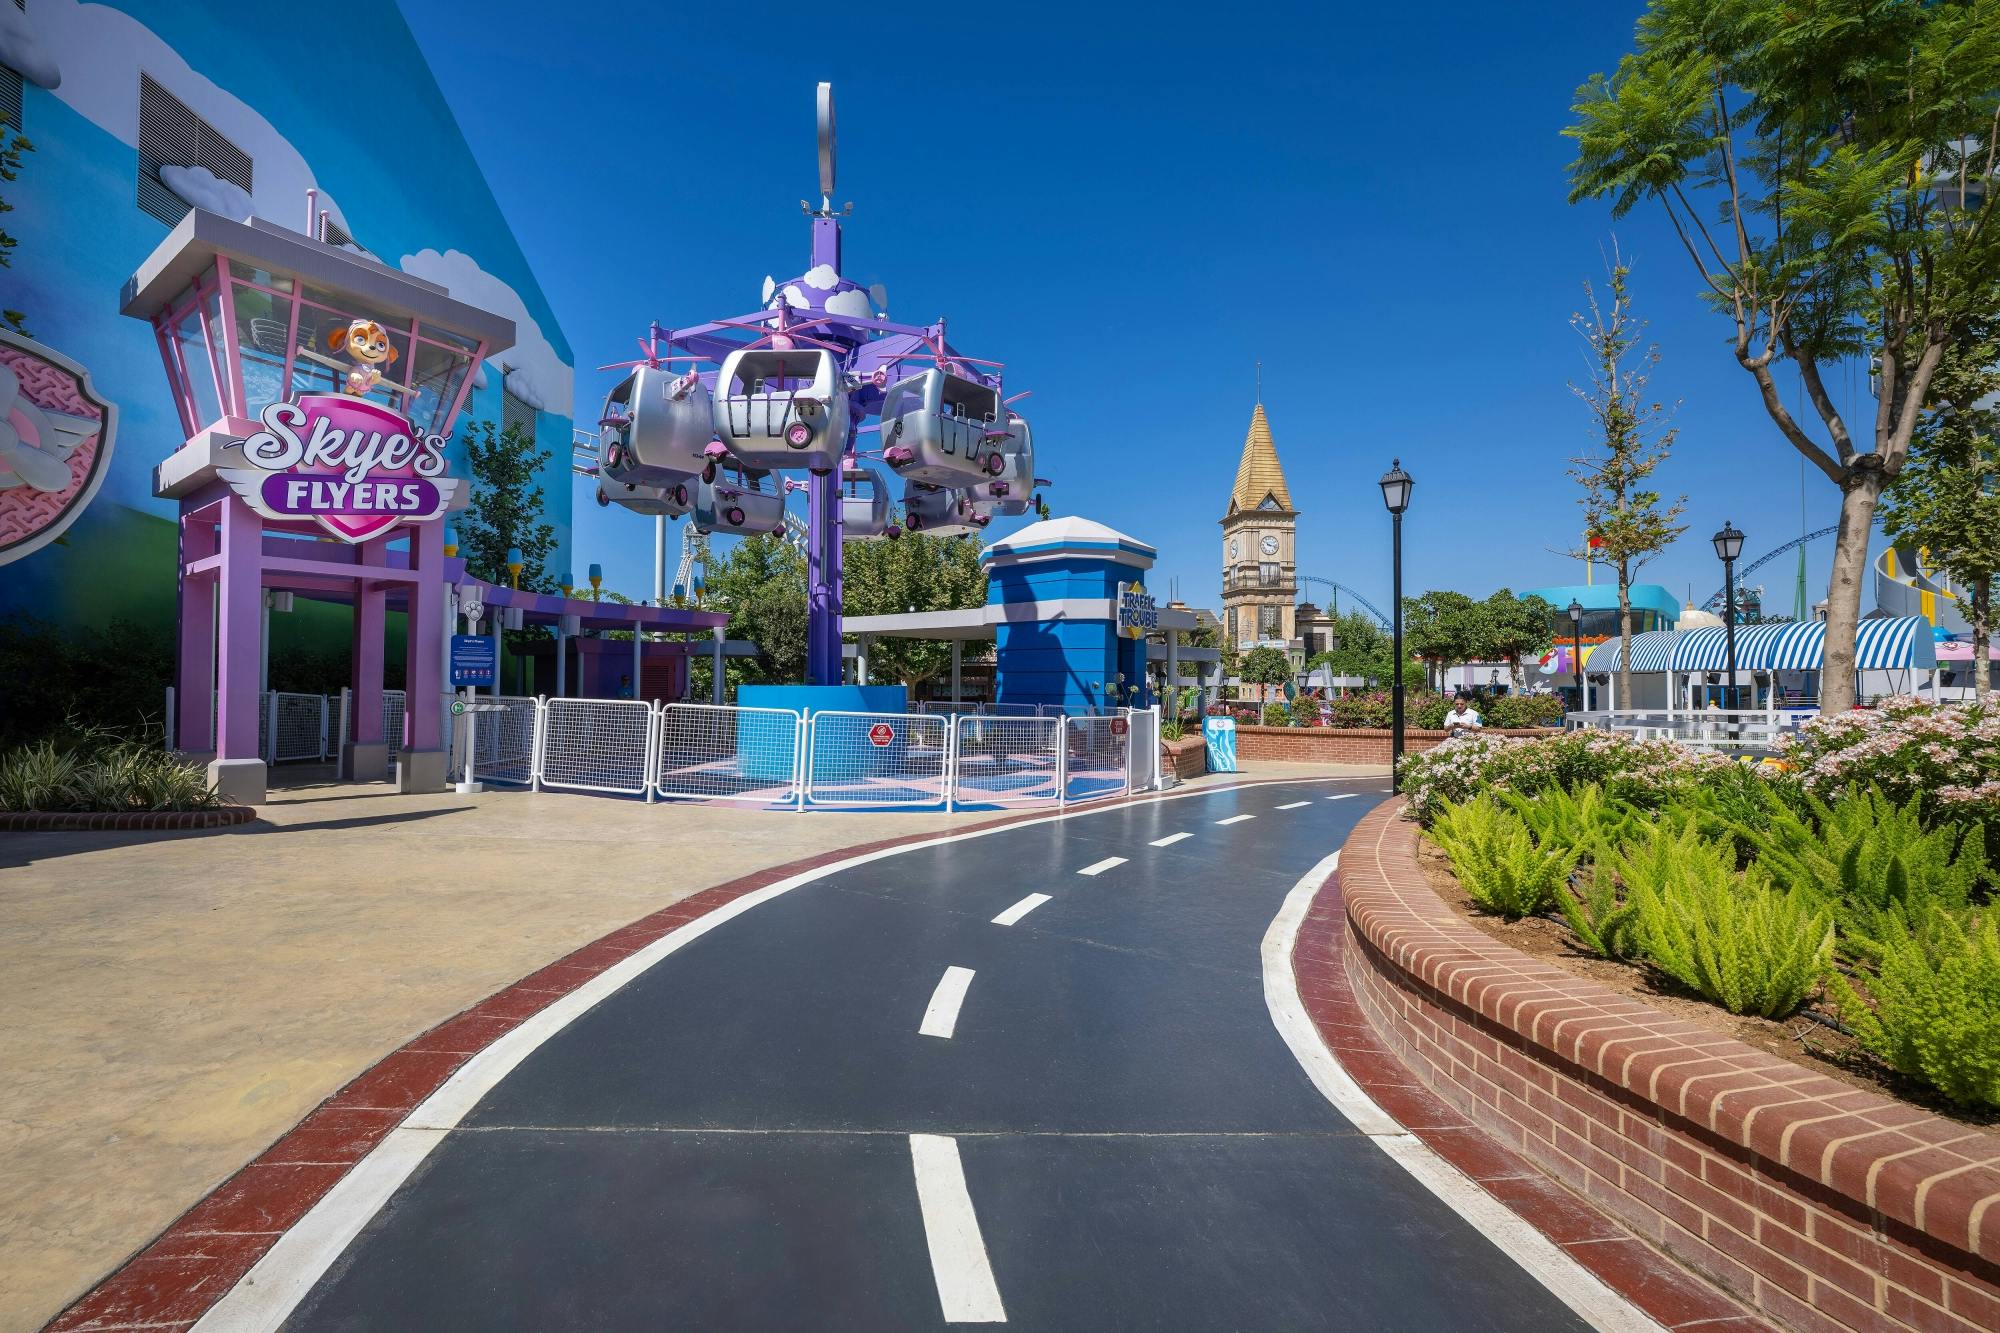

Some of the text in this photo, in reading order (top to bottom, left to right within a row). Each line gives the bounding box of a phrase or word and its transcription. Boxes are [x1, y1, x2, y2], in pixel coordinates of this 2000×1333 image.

[224, 402, 453, 484] Skye's
[286, 480, 420, 511] FLYERS
[1123, 592, 1156, 611] TRAFFIC
[1119, 608, 1159, 629] TROUBLE
